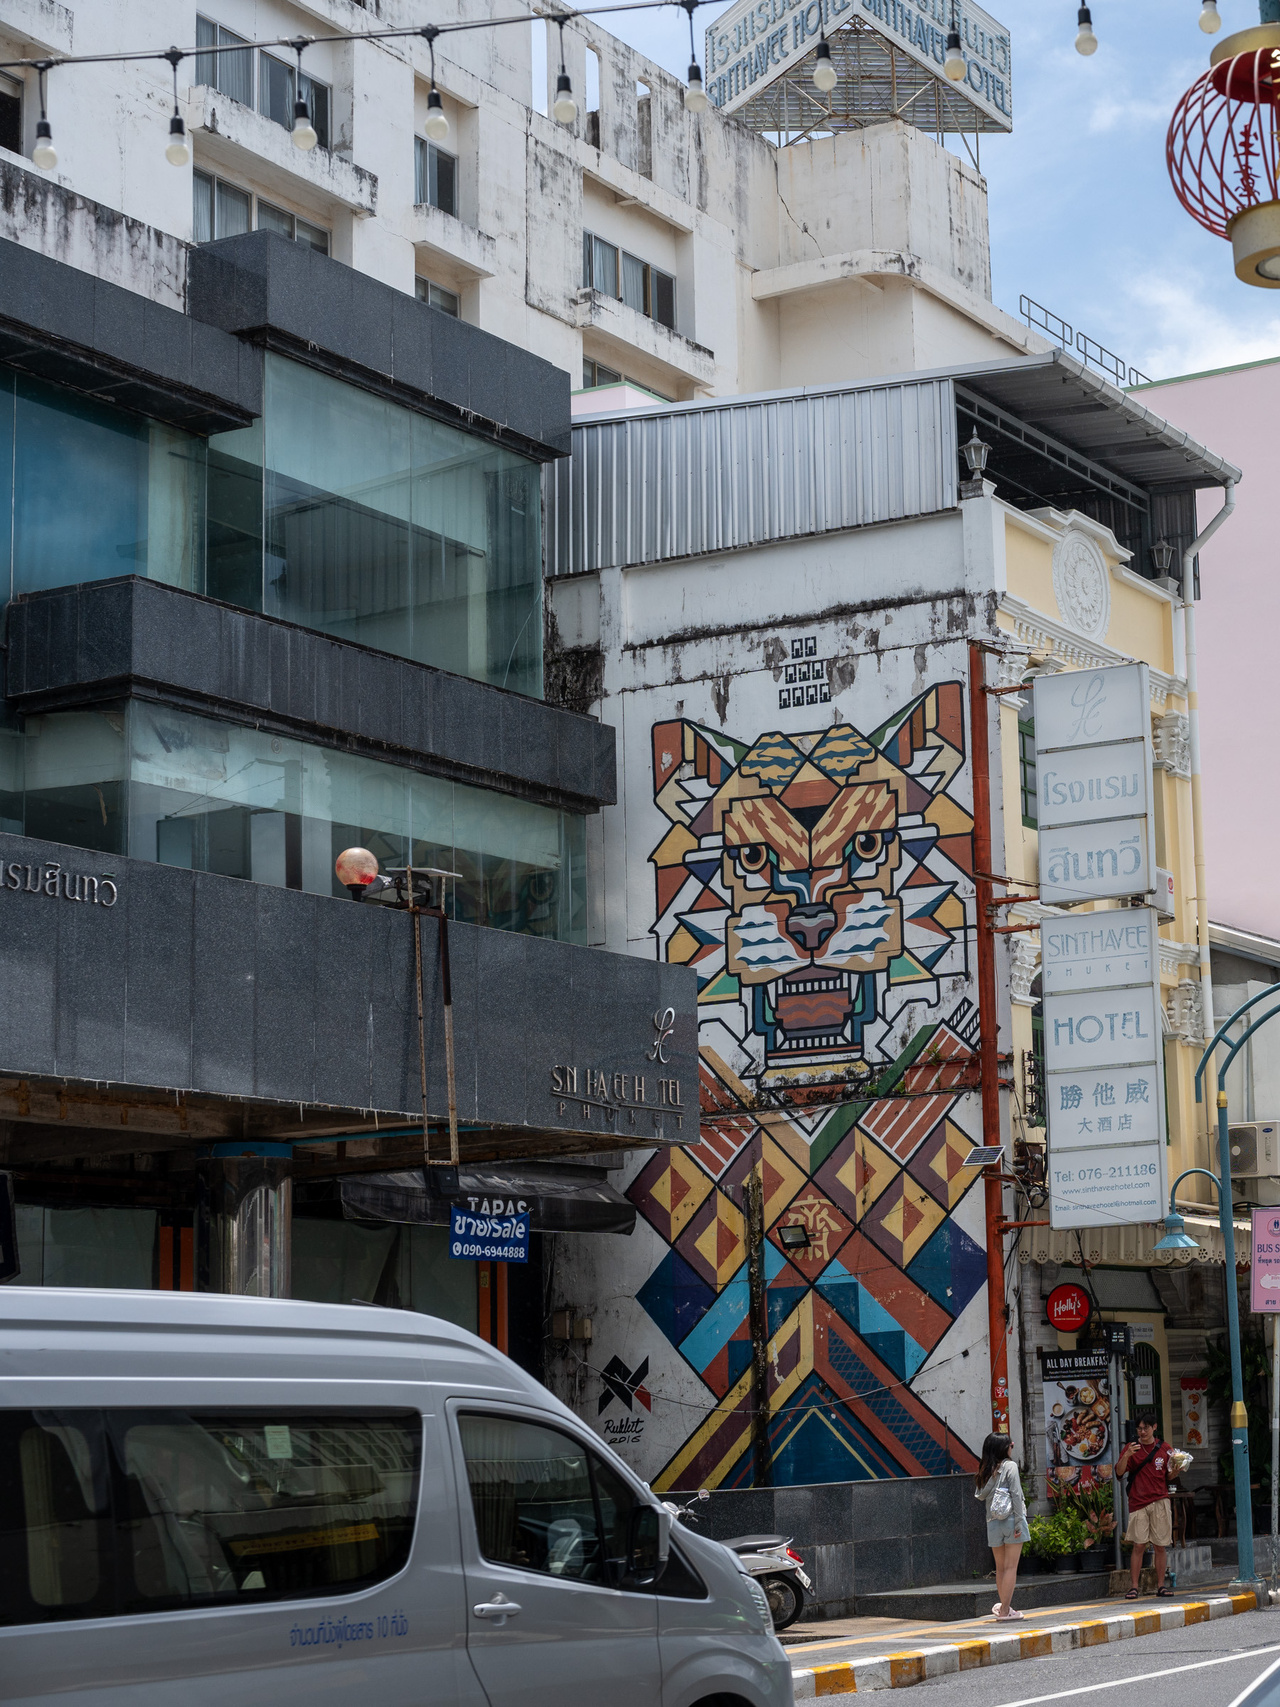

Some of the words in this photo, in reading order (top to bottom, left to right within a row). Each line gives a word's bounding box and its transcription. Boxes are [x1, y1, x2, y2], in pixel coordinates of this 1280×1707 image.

[1043, 771, 1139, 807] โรงแรม
[1047, 835, 1142, 884] สินทวี
[1047, 924, 1149, 958] SINTHAVEE
[1053, 1011, 1149, 1046] HOTEL
[1059, 1078, 1149, 1111] 勝他威
[1077, 1113, 1133, 1134] 大酒店
[1054, 1170, 1075, 1183] Tel:
[1061, 1181, 1151, 1196] www.sinthaveehotel.com
[462, 1244, 525, 1258] 090-6944888
[1257, 1243, 1273, 1253] BUS
[1054, 1296, 1082, 1317] Holly's
[1046, 1358, 1059, 1369] ALL
[1059, 1357, 1072, 1368] DAY
[1074, 1355, 1109, 1367] BREAKFAS
[1243, 1444, 1248, 1454] 2
[377, 1615, 389, 1638] 10
